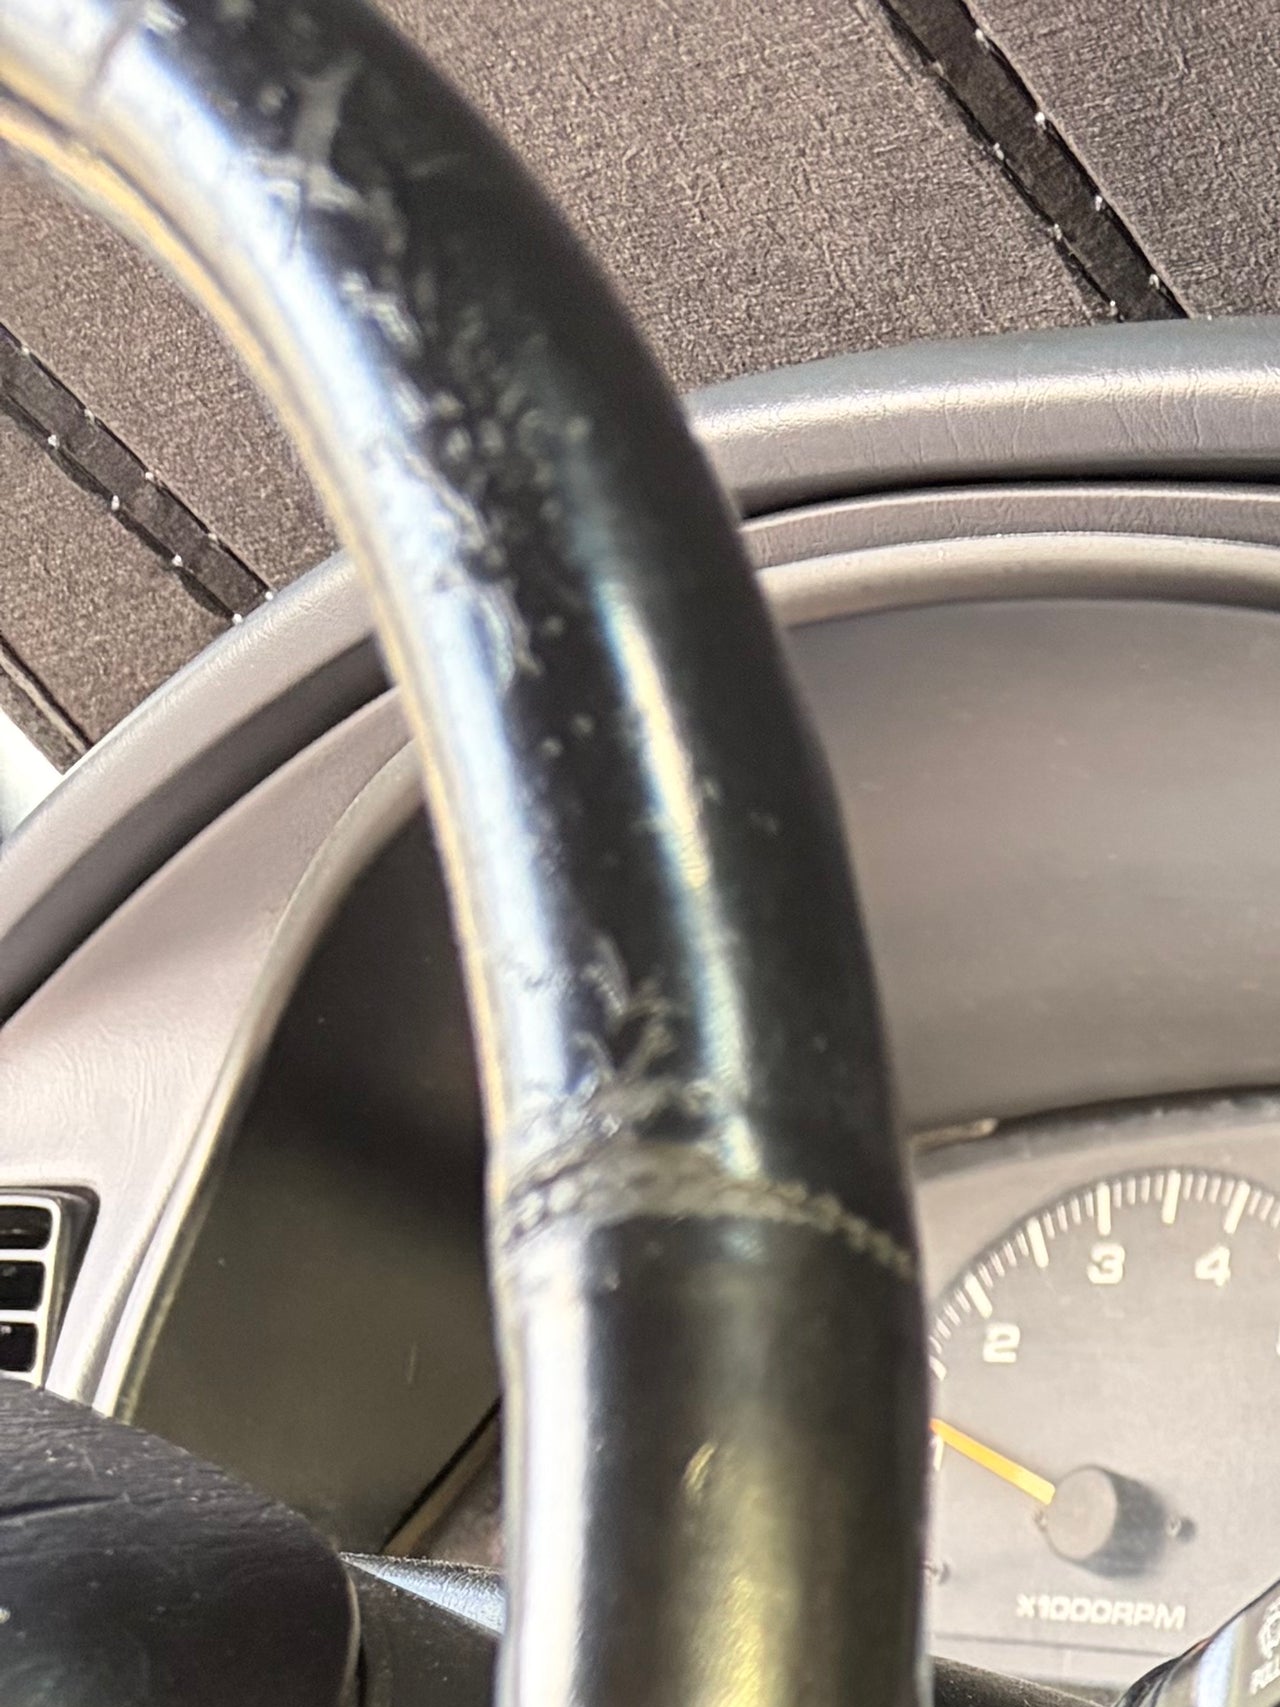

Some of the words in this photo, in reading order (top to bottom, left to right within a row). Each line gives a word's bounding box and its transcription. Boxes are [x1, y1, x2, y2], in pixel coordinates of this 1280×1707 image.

[1087, 1243, 1126, 1284] 3
[1194, 1246, 1231, 1288] 4
[982, 1323, 1020, 1363] 2
